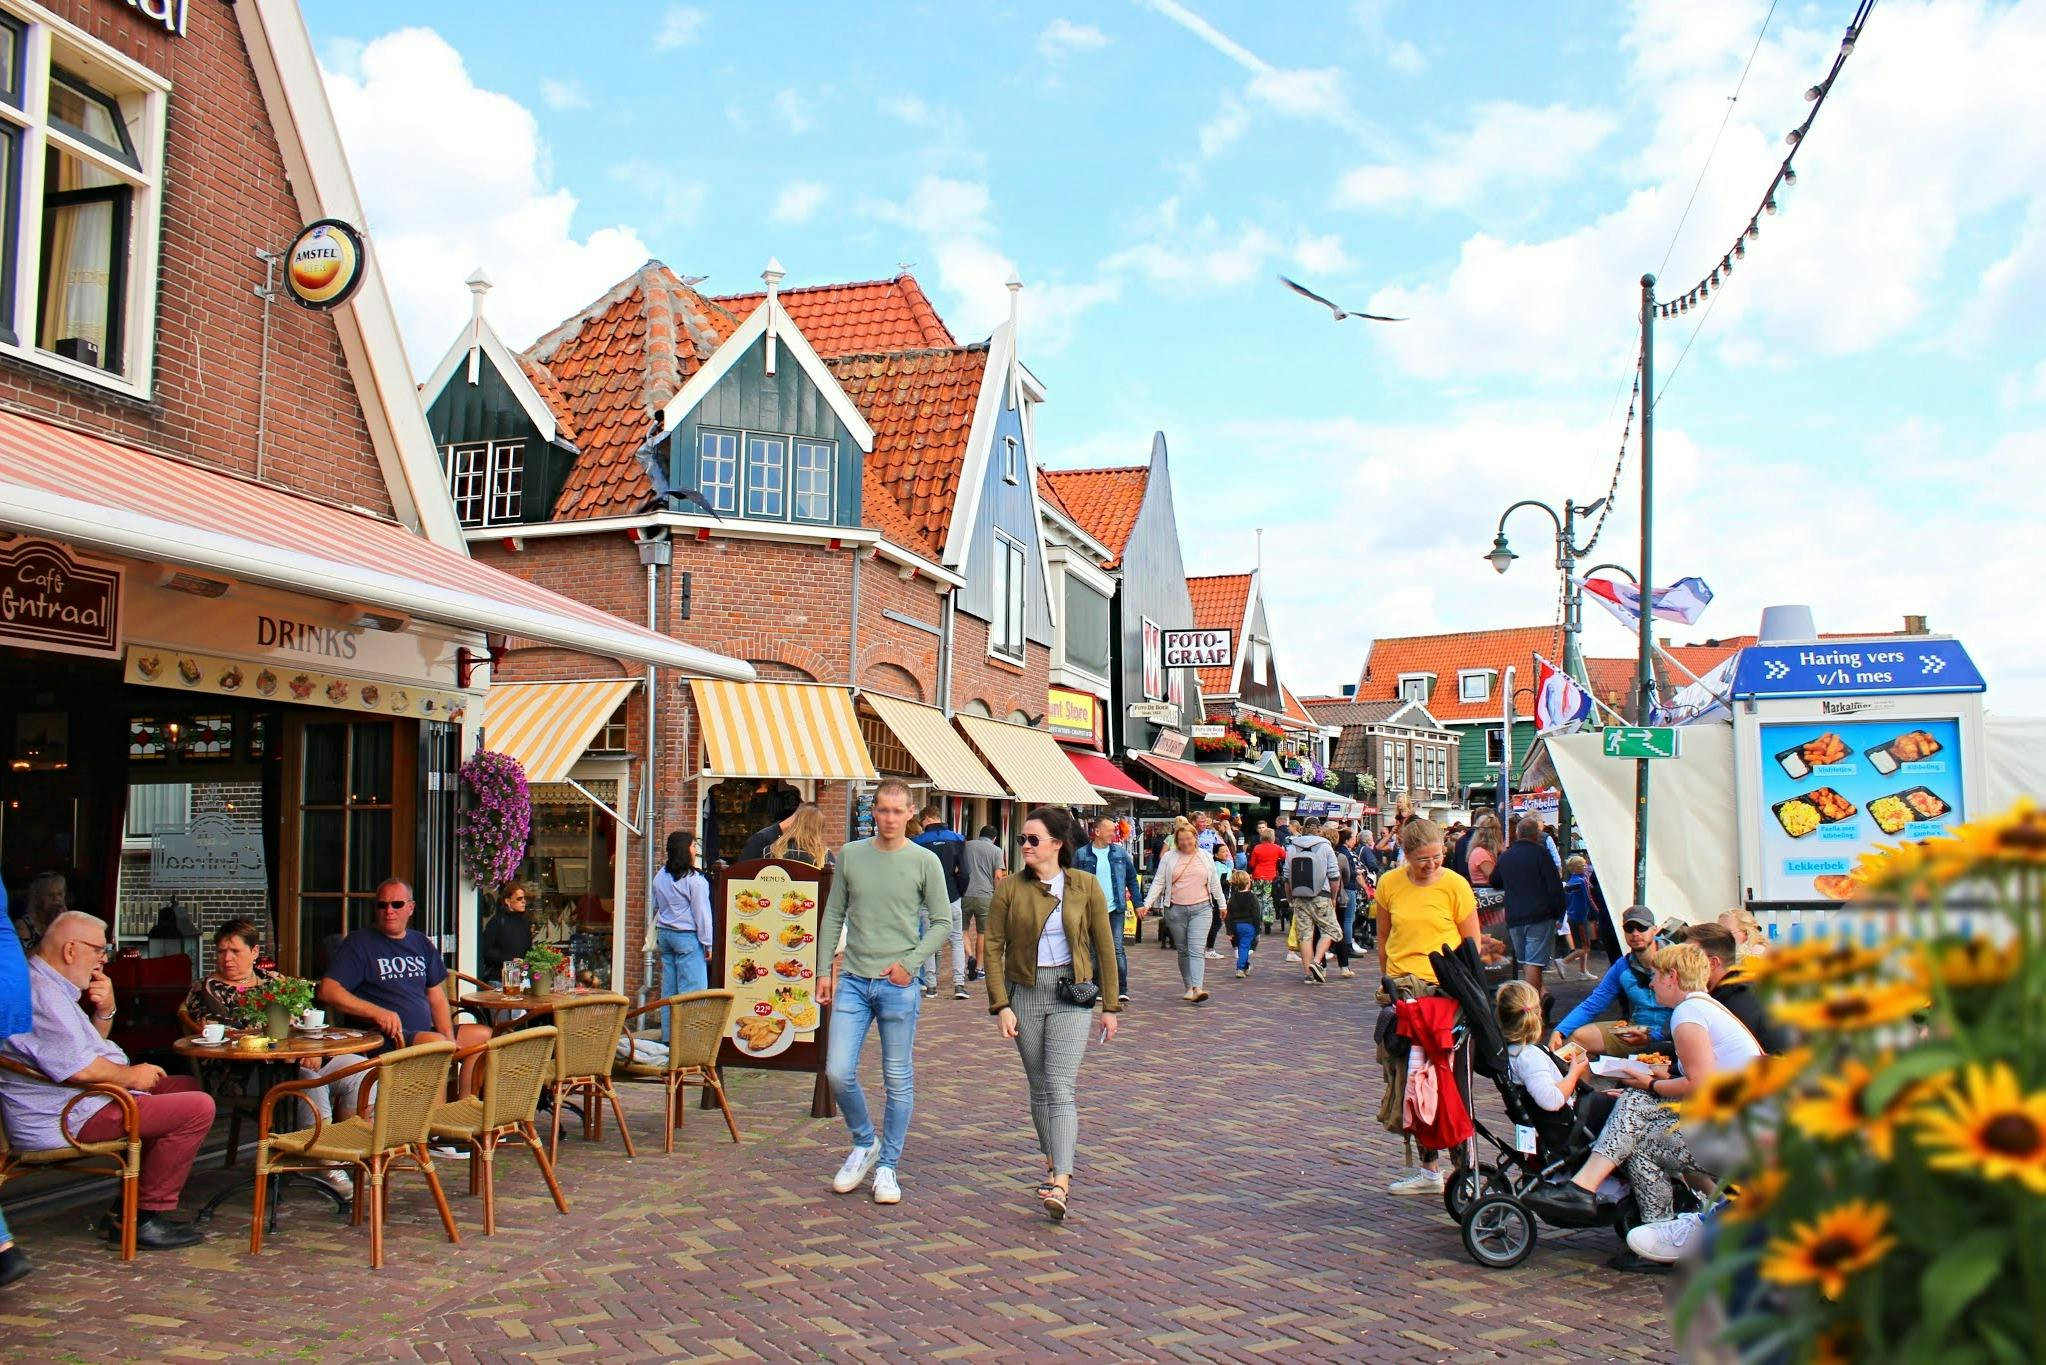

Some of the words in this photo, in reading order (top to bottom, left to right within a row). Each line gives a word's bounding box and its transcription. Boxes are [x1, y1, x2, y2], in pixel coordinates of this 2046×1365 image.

[295, 248, 338, 263] AMSTEL
[256, 615, 357, 660] DRINKS
[1168, 633, 1224, 648] FOTO-
[1167, 649, 1228, 665] GRAAF
[1799, 649, 1861, 669] Haring
[1866, 650, 1904, 664] vers
[1816, 669, 1850, 686] v/h
[1855, 671, 1893, 683] mes
[1788, 862, 1845, 871] Lekkerbek
[377, 956, 426, 976] BOSS
